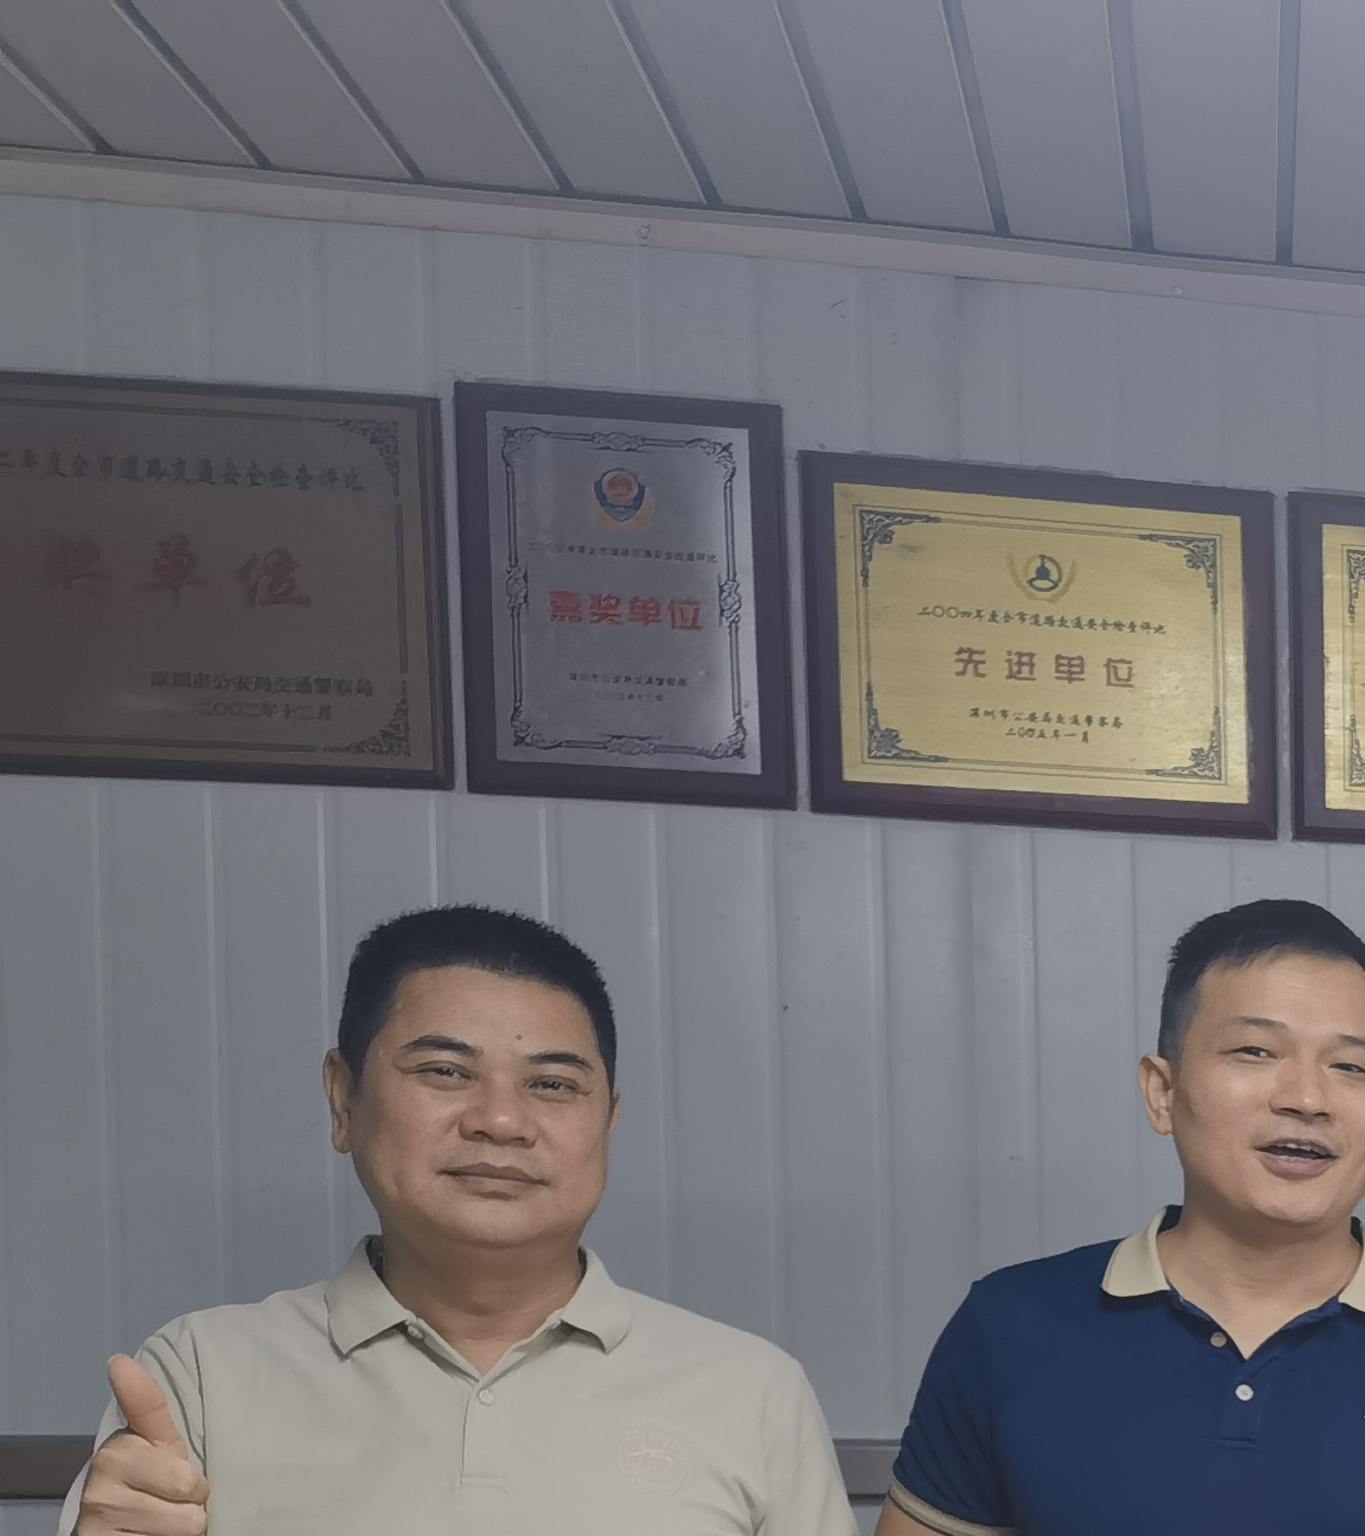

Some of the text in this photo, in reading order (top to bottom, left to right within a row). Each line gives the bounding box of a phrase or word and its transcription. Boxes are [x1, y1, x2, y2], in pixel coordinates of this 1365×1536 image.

[548, 589, 704, 632] 嘉奖单位
[954, 645, 1136, 689] 先进单位
